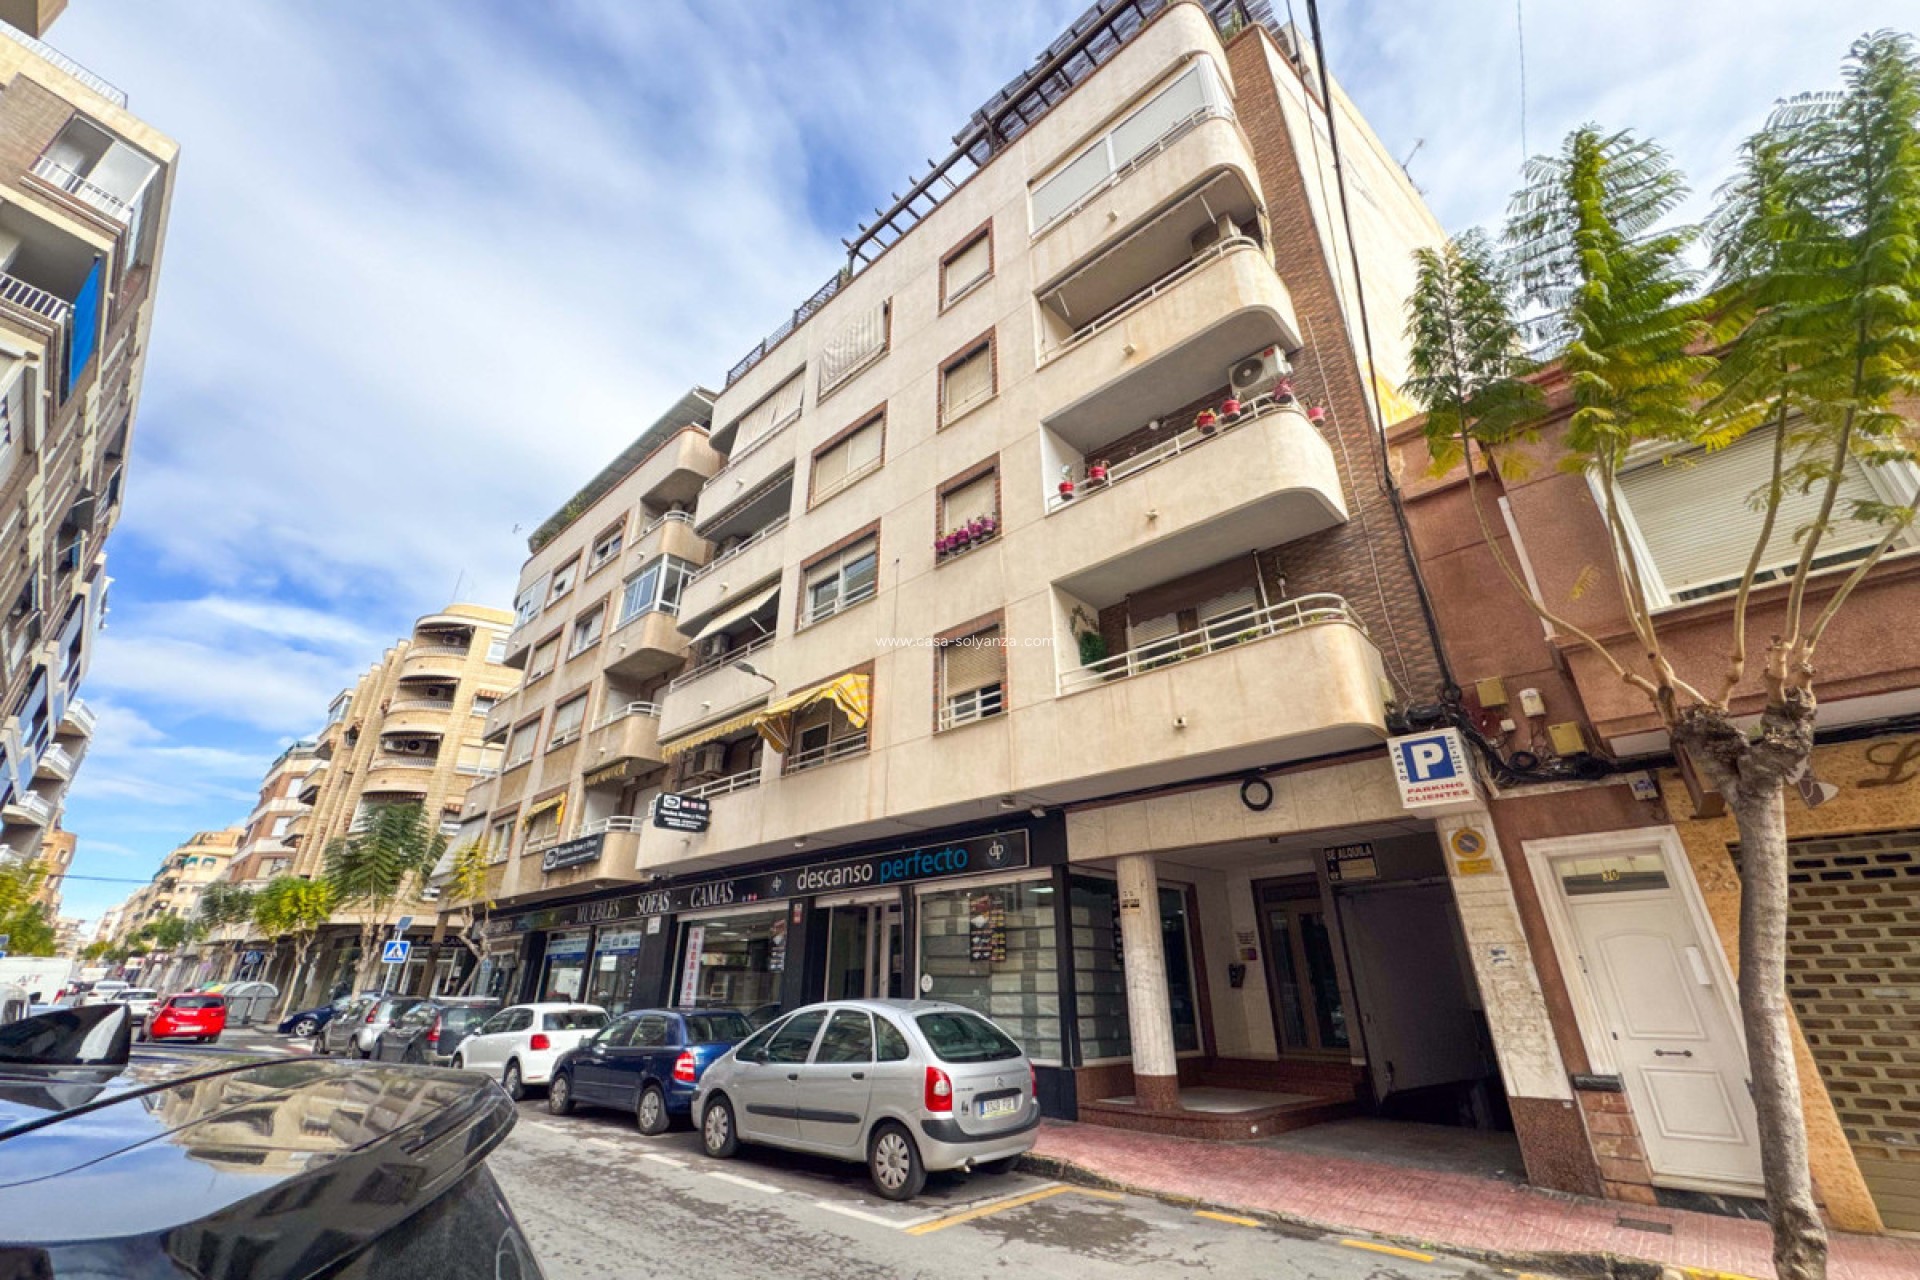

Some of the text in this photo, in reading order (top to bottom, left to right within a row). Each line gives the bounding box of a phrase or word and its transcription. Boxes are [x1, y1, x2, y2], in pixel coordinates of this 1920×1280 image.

[1410, 742, 1444, 780] P
[1406, 789, 1470, 803] CLIENTES
[1407, 781, 1465, 795] PARKING
[1338, 844, 1372, 859] ALQUILA
[796, 847, 970, 890] descanso perfecto
[576, 900, 620, 923] MUEBLES
[690, 880, 735, 908] CAMAS
